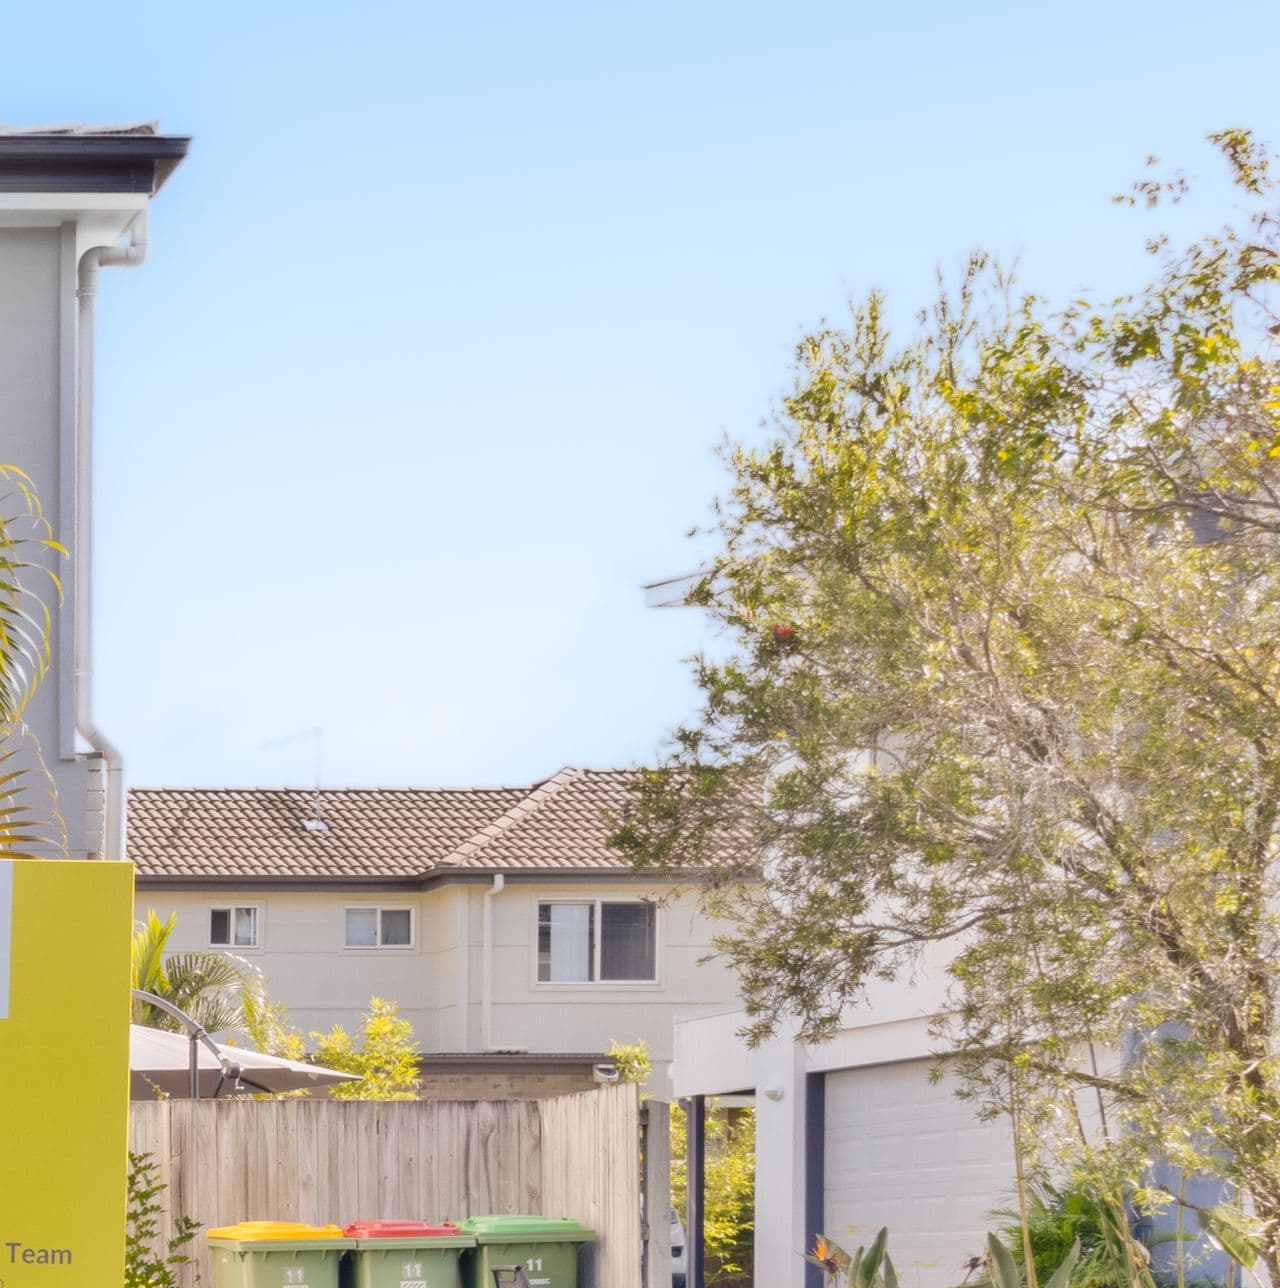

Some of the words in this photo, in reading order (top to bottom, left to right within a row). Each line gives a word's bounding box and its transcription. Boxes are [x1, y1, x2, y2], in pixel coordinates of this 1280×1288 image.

[5, 1242, 72, 1264] Team
[404, 1263, 422, 1277] 11
[526, 1258, 542, 1271] 11
[286, 1269, 304, 1283] 11
